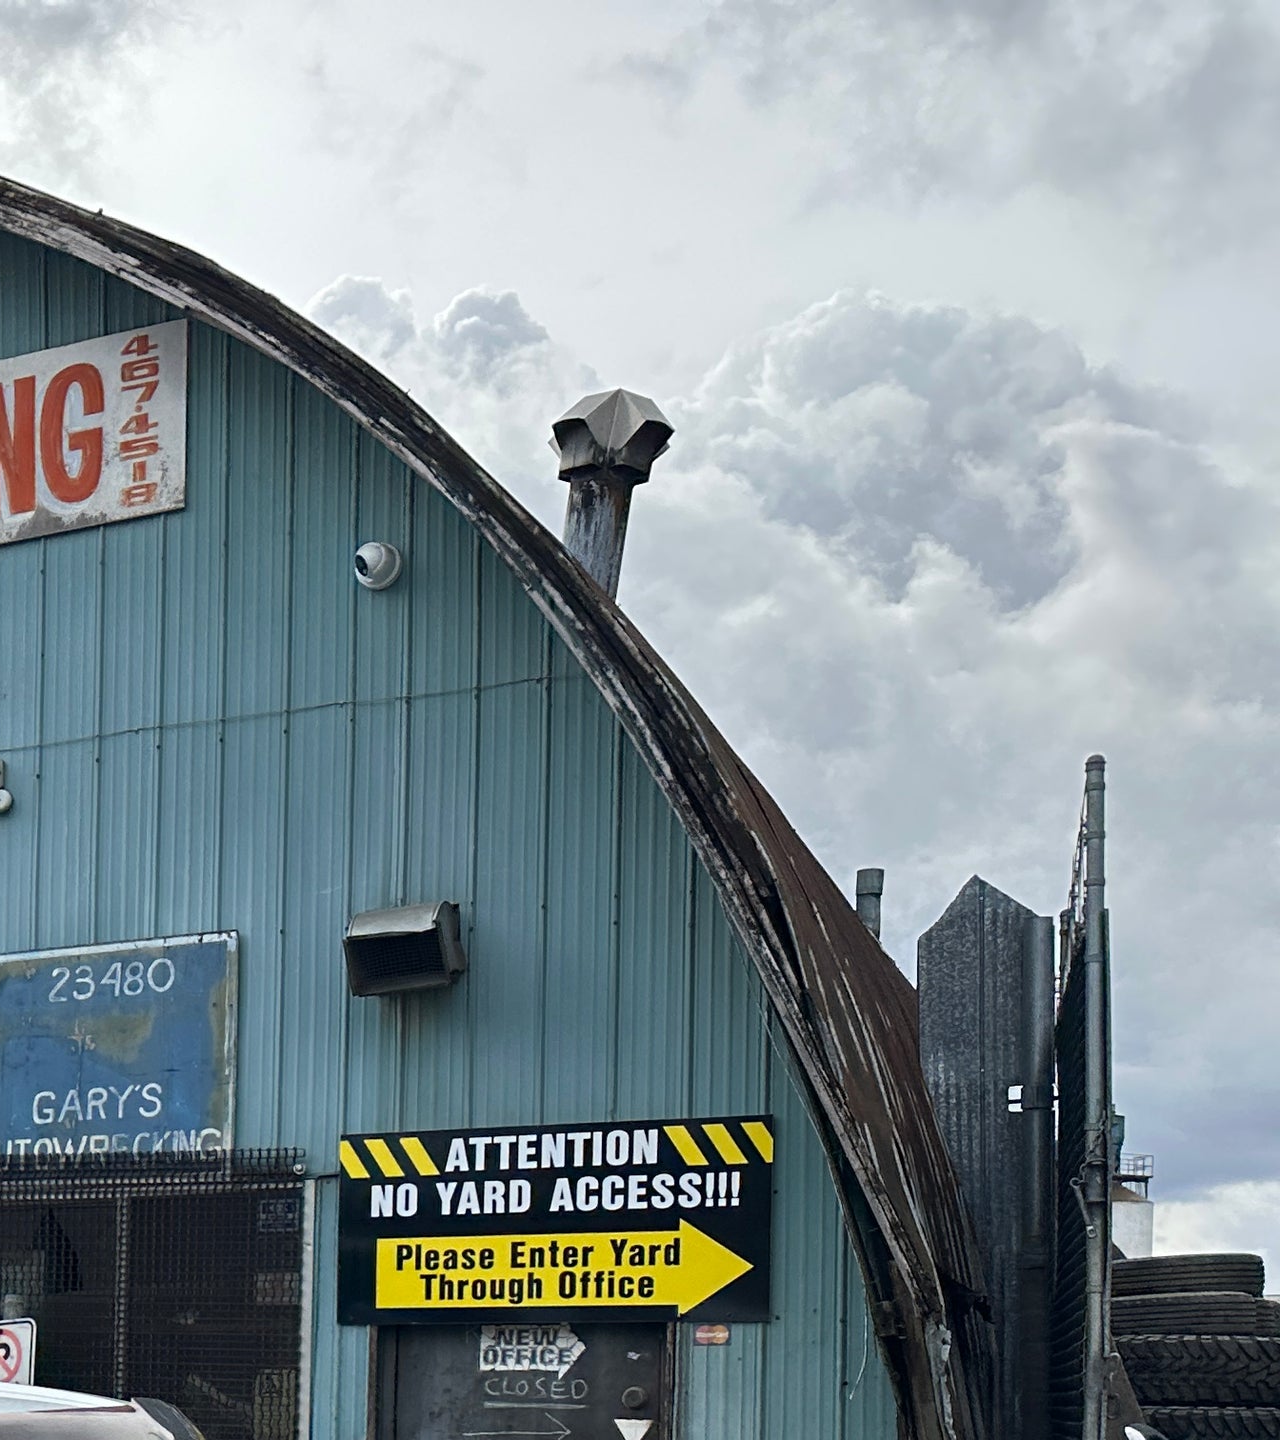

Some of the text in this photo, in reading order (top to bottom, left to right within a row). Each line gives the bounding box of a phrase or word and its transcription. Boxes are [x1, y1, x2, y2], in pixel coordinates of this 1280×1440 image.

[48, 957, 176, 1002] 23480
[31, 1083, 164, 1125] GARY'S
[444, 1128, 660, 1173] ATTENTION
[370, 1171, 741, 1218] NO YARD ACCESS!!!
[395, 1237, 681, 1272] Please Enter Yard
[419, 1271, 655, 1305] Through Office
[496, 1328, 558, 1346] NEW
[482, 1345, 574, 1367] OFFICE
[484, 1377, 589, 1400] CLOSED
